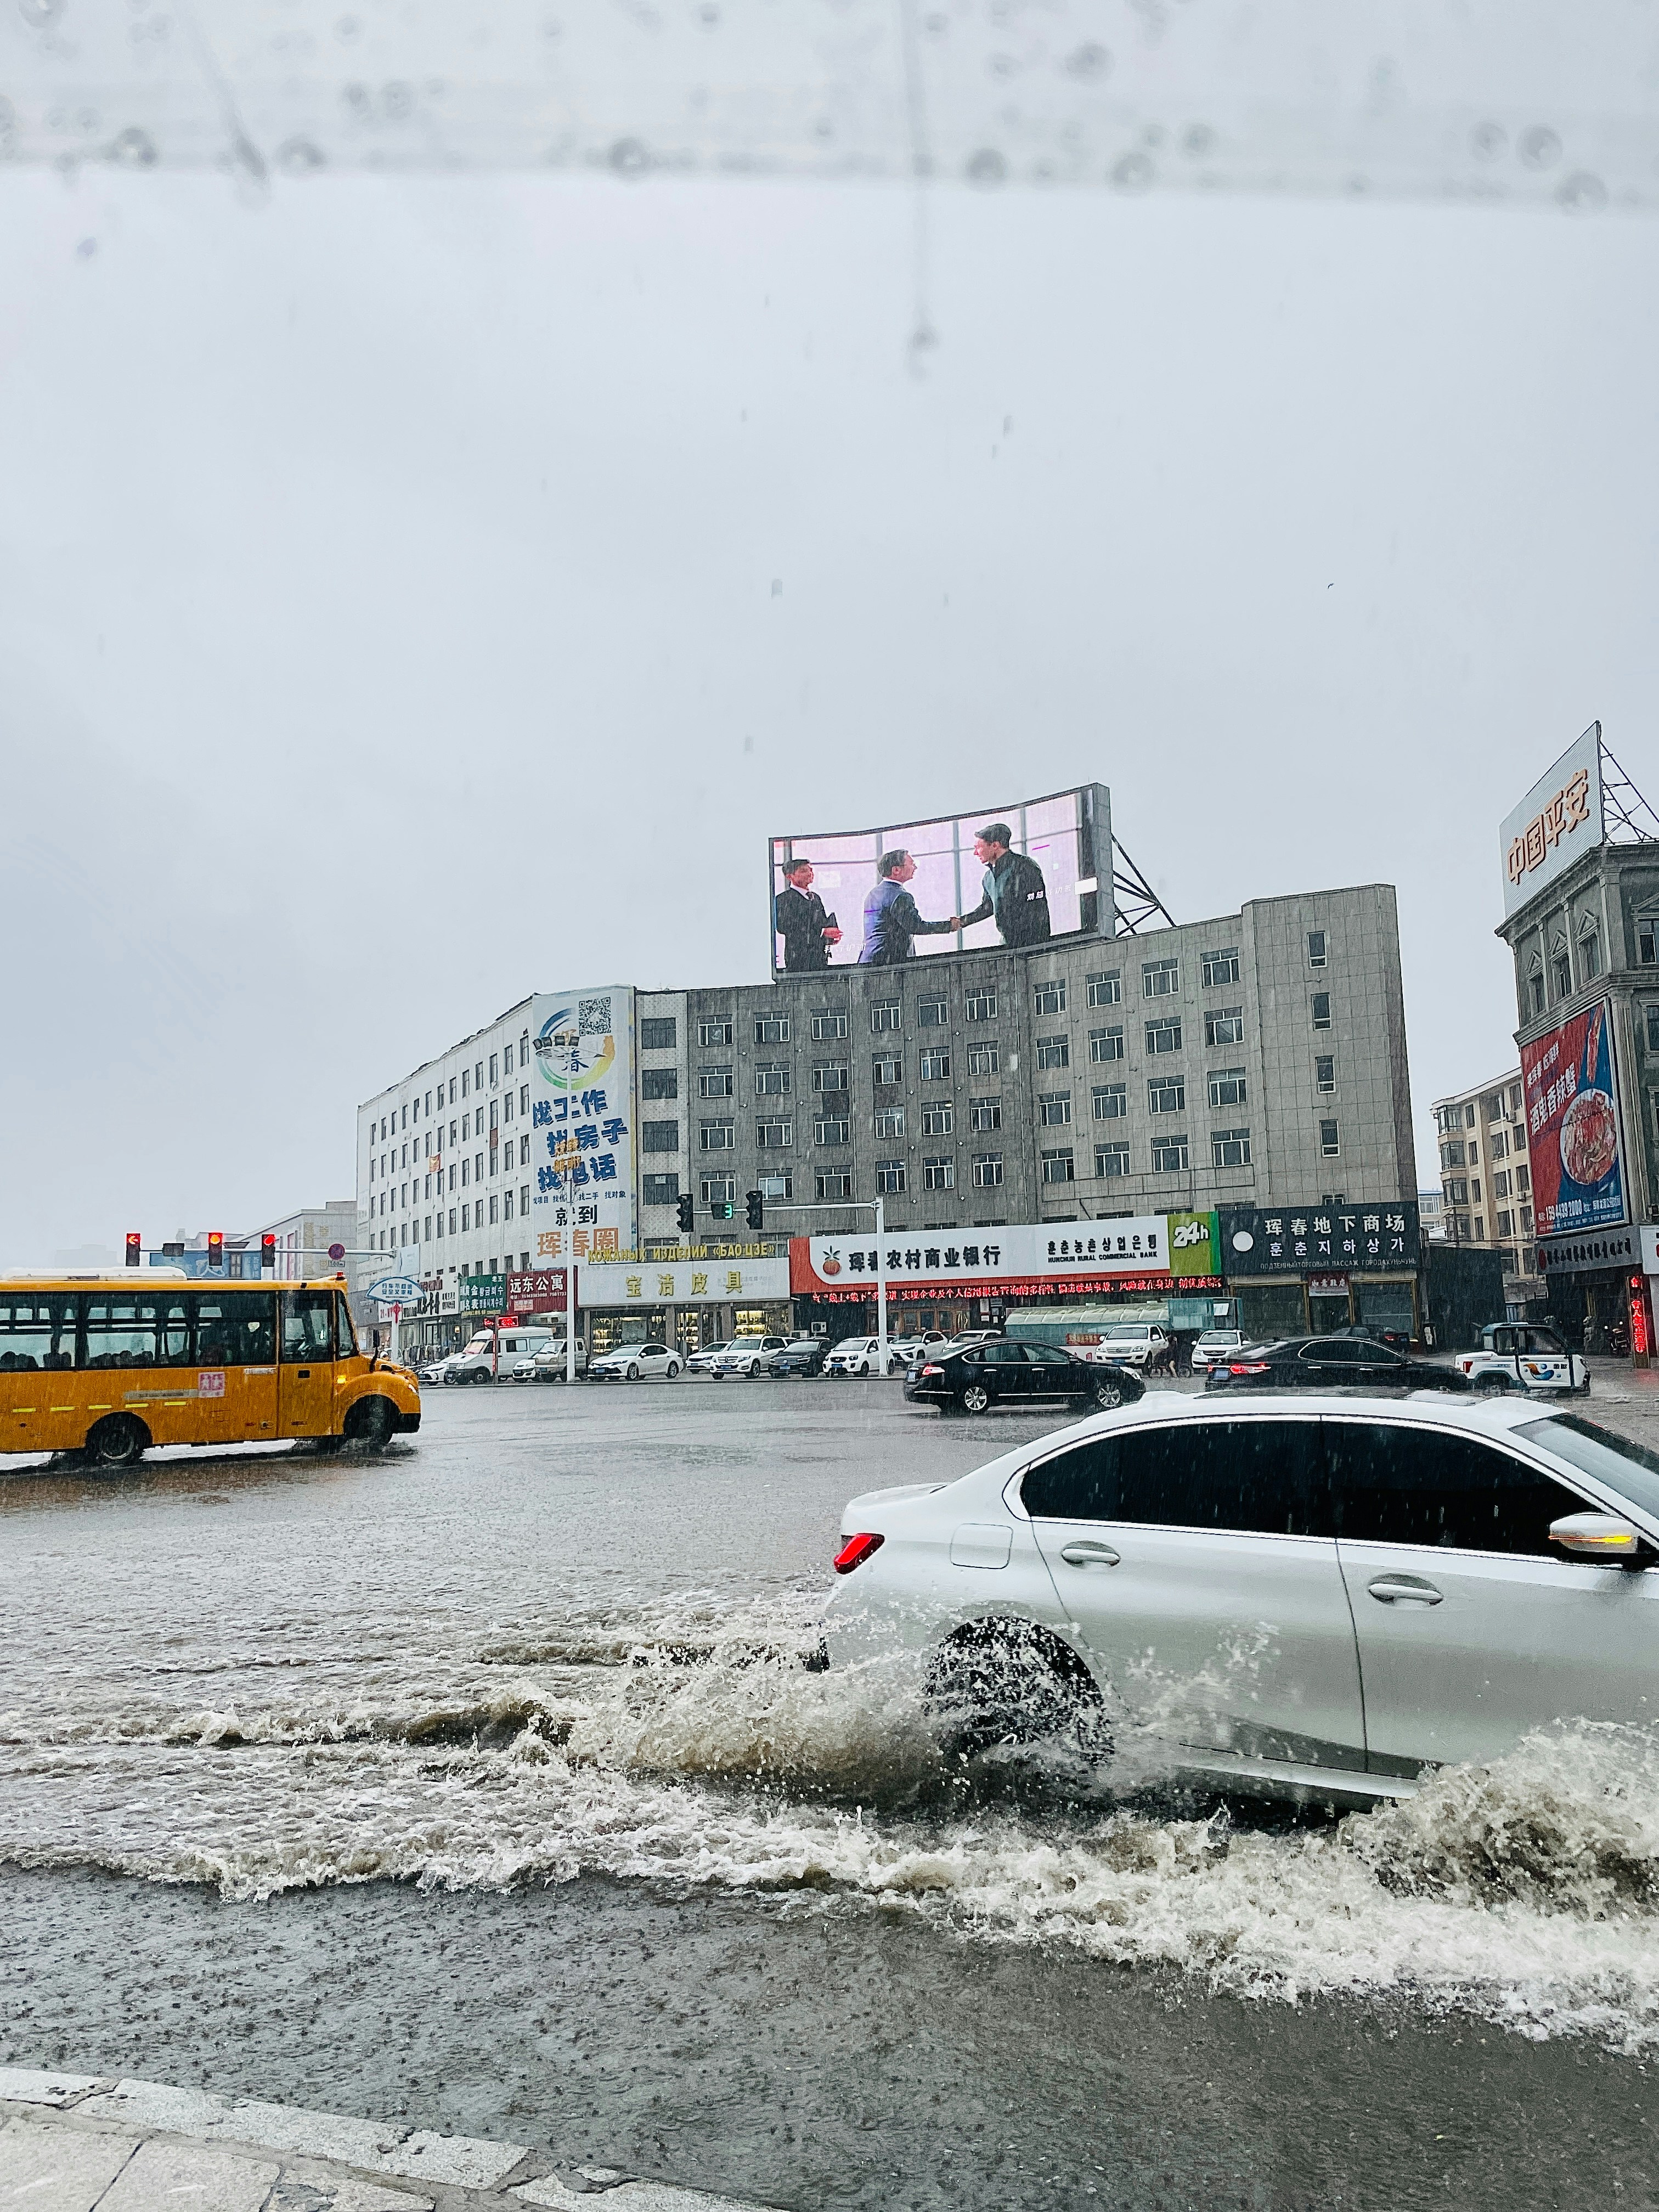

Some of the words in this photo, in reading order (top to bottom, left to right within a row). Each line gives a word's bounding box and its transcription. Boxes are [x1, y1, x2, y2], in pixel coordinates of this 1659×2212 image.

[1507, 769, 1589, 885] 中国平安
[579, 1192, 599, 1201] 找二手
[605, 1190, 626, 1199] 找对象
[725, 1205, 732, 1218] 3
[1172, 1221, 1210, 1248] 24h
[1265, 1214, 1405, 1235] 珲春地下商场
[588, 1248, 646, 1262] КОЖАНЫХ
[653, 1244, 708, 1260] ИЗДЕЛИЙ
[1099, 1252, 1136, 1260] COMMERCIAL
[1269, 1237, 1404, 1256] 훈춘지하상가
[849, 1245, 1001, 1272] 珲春农村商业银行
[510, 1274, 563, 1294] 远东公寓
[625, 1271, 742, 1297] 宝洁皮具
